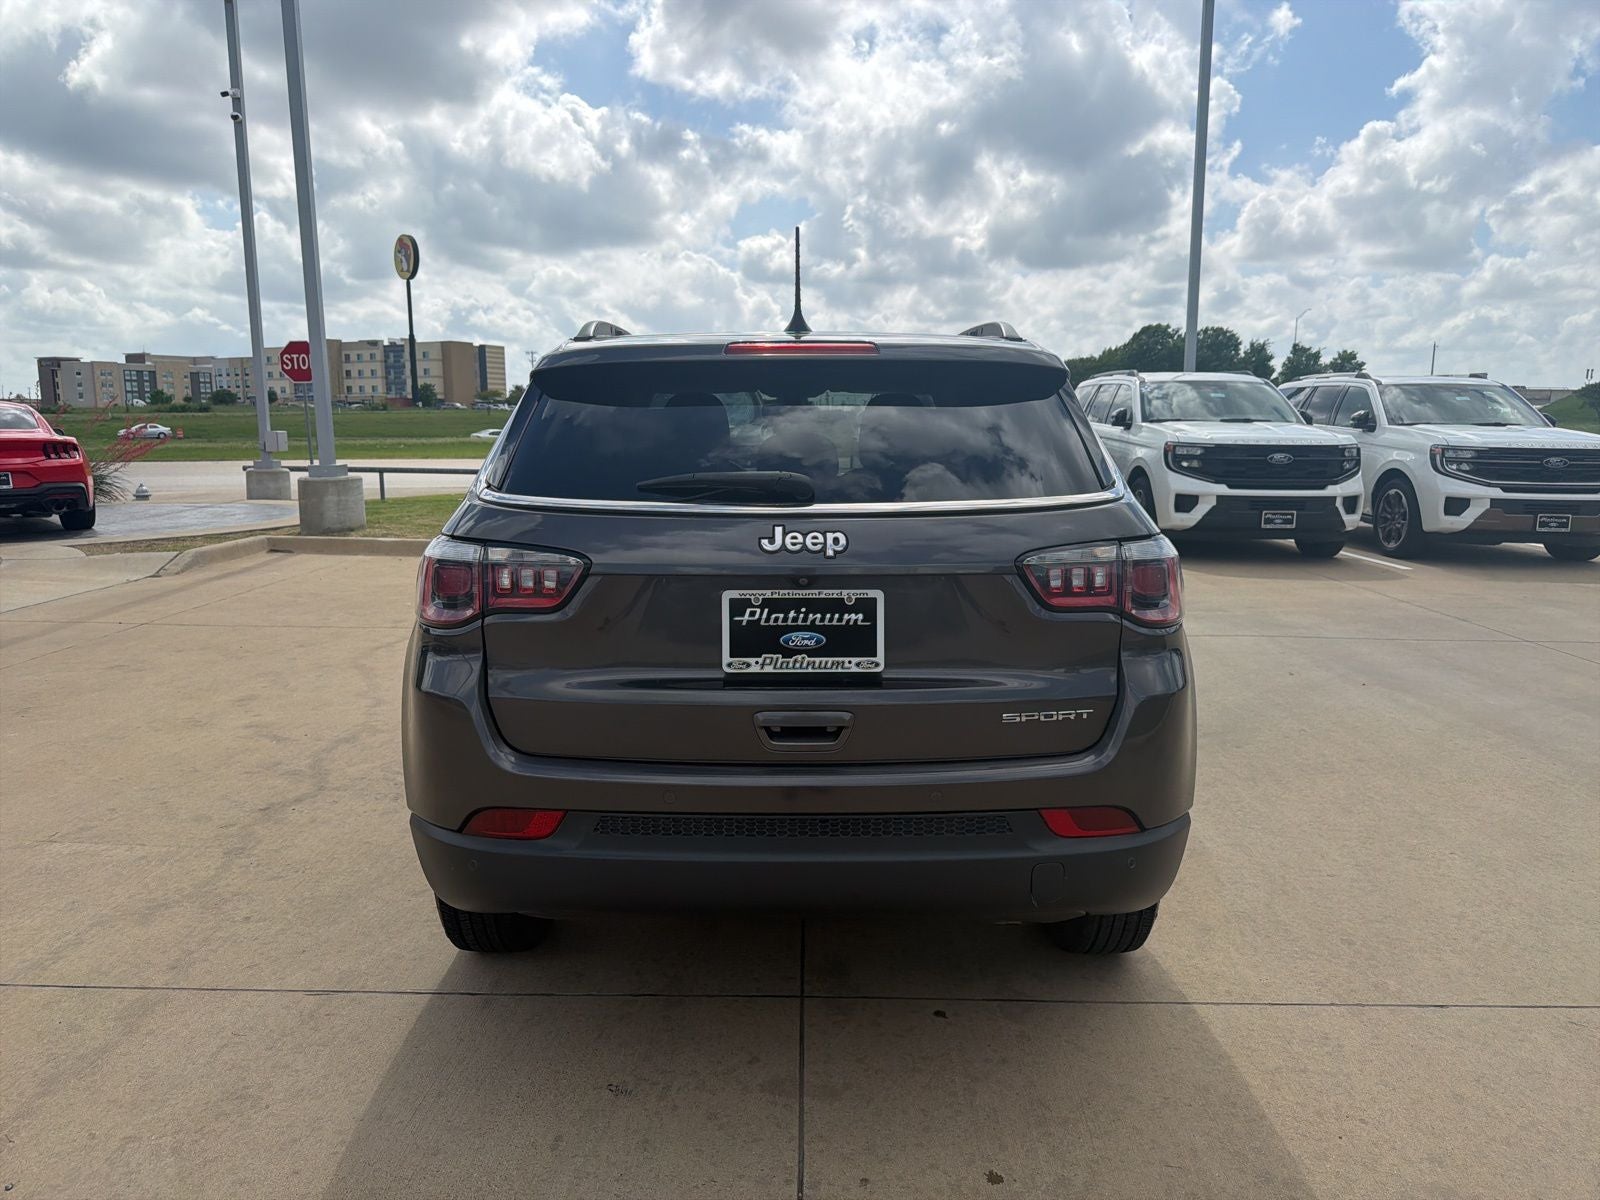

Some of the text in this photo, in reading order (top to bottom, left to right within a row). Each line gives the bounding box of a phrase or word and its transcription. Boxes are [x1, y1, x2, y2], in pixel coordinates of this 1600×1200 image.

[282, 354, 309, 370] STO
[760, 525, 848, 558] Jeep
[733, 607, 872, 626] Platinum
[788, 634, 817, 647] Ford
[759, 654, 851, 670] Platinum
[1002, 709, 1094, 723] SPORT
